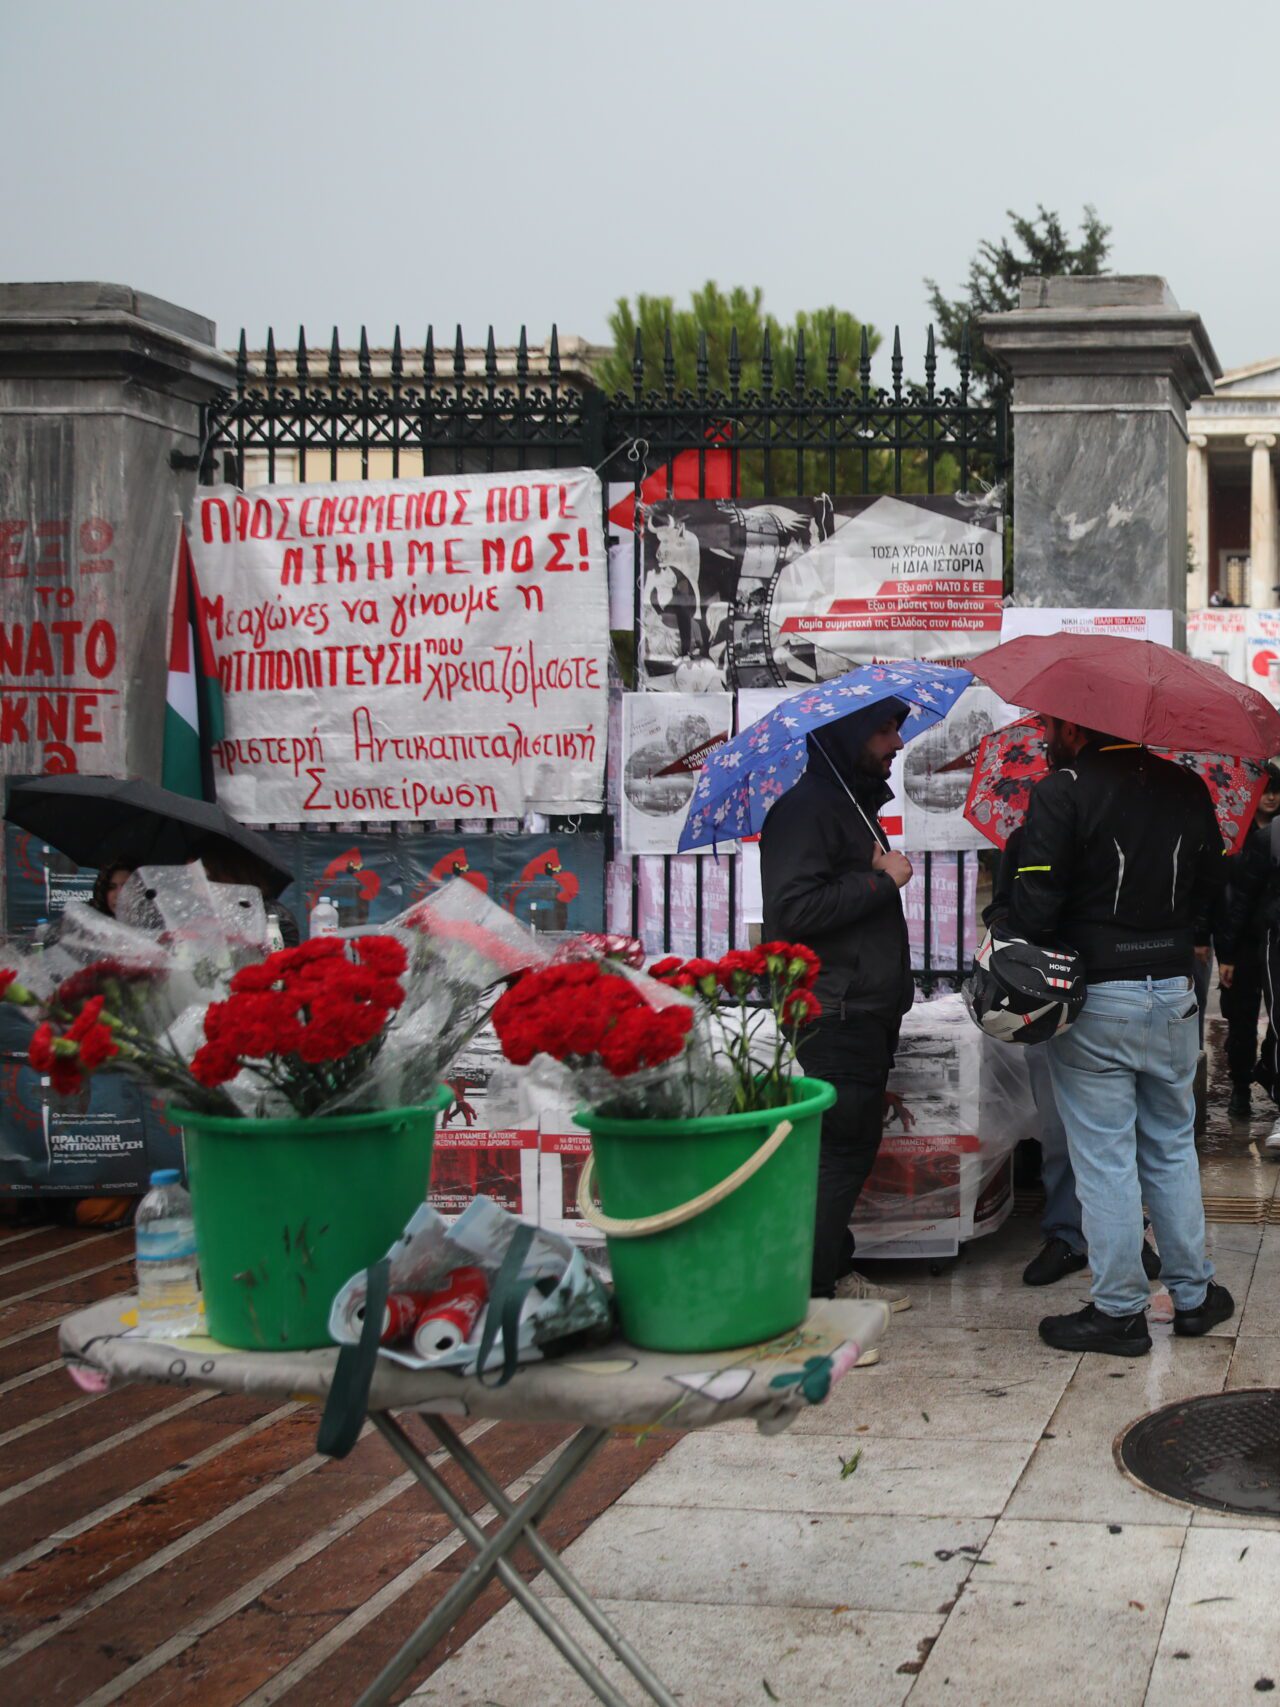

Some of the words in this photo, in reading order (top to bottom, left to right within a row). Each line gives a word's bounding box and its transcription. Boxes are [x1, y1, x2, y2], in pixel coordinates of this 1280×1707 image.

[486, 483, 579, 525] ΠΟΤΕ
[871, 545, 899, 559] ΤΟΣΑ
[903, 543, 945, 559] ΧΡΟΝΙΑ
[949, 542, 985, 556] ΝΑΤΟ
[891, 563, 899, 574] Η
[903, 559, 929, 574] ΙΔΙΑ
[933, 558, 984, 573] ΙΣΤΟΡΙΑ
[867, 599, 886, 612] Έξω
[888, 600, 896, 610] οι
[897, 599, 927, 612] βάσεις
[930, 601, 945, 610] του
[947, 599, 985, 611] θανάτου
[896, 582, 915, 594] Έξω
[917, 581, 933, 593] από
[936, 581, 960, 592] ΝΑΤΟ
[963, 581, 970, 592] &
[342, 598, 378, 625] να
[390, 583, 499, 637] γίνουμε
[516, 584, 544, 612] η
[798, 618, 823, 632] Καμία
[825, 618, 873, 632] συμμετοχή
[875, 619, 889, 630] της
[891, 616, 927, 629] Ελλάδας
[930, 619, 950, 628] στον
[951, 617, 985, 630] πόλεμο
[218, 642, 422, 694] ΝΤΙΠΟΛΙΤΕΥΣΗ
[424, 640, 600, 708] χρειαζόμαστε
[353, 706, 597, 766] Αντικαπιταλιστική
[303, 767, 498, 816] Συσπείρωση
